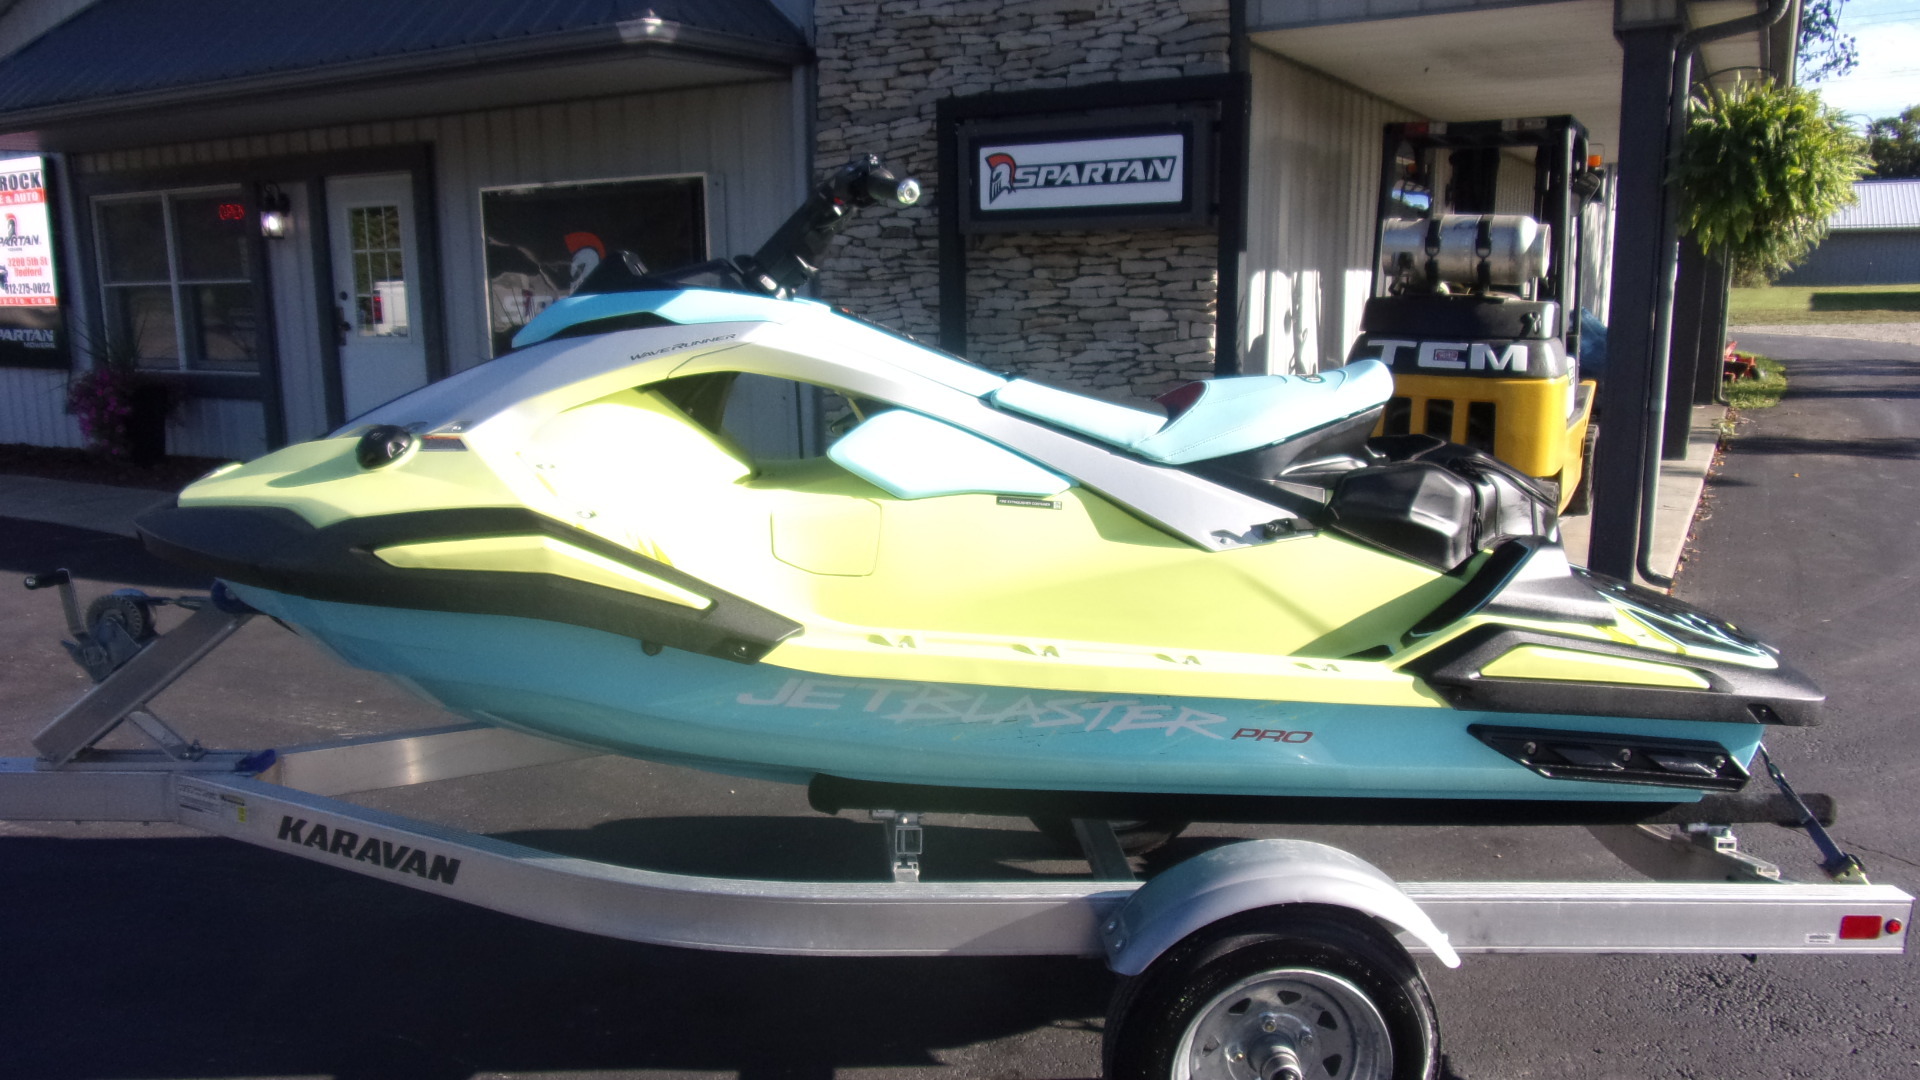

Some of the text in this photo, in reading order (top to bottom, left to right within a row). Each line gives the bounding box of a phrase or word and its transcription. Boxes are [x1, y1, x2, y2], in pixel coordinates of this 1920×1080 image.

[0, 171, 41, 191] ROCK
[1014, 157, 1176, 188] SPARTAN
[14, 191, 39, 202] AUTO
[219, 204, 245, 220] OPEN
[1367, 340, 1528, 372] TCM
[1231, 727, 1314, 744] PRO
[277, 815, 461, 885] KARAVAN
